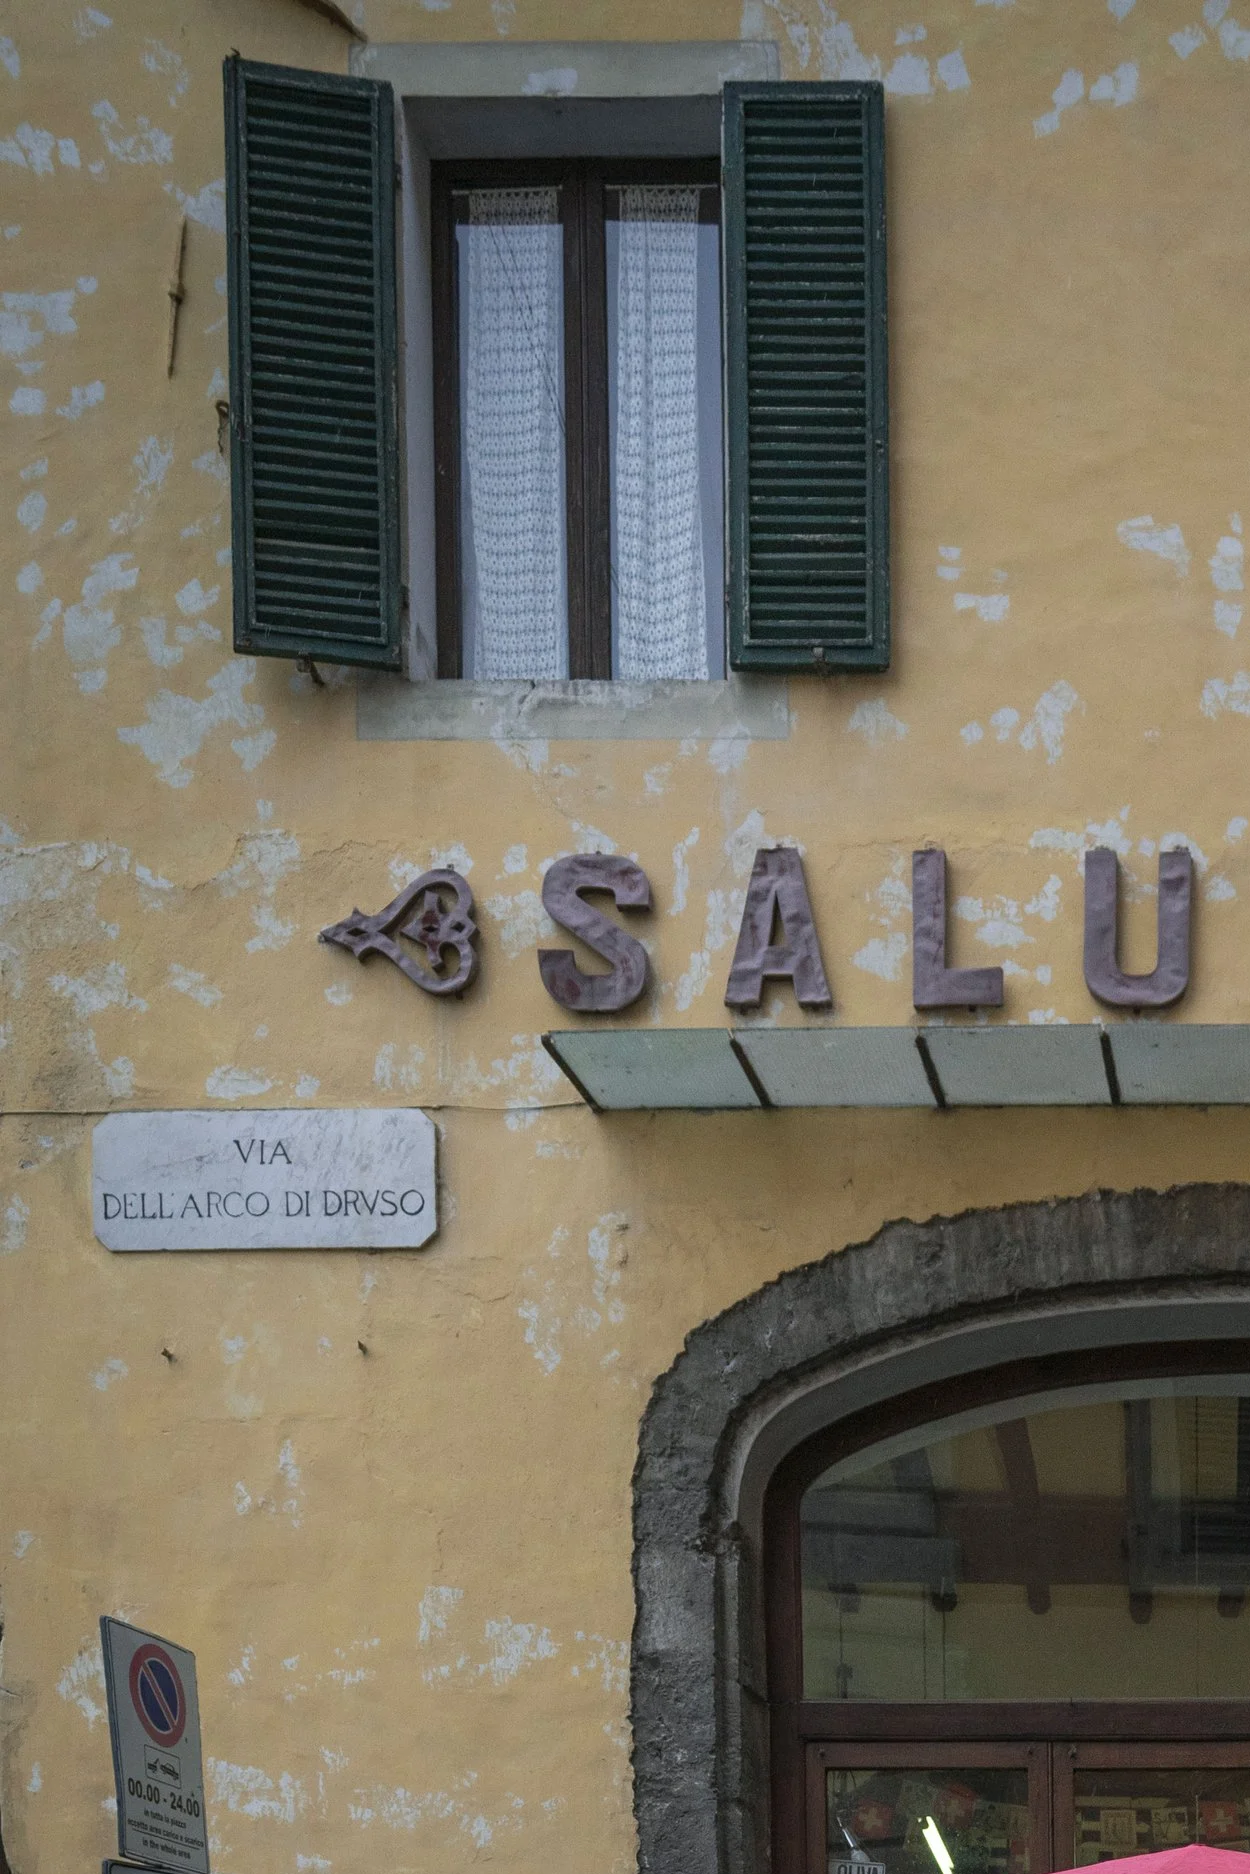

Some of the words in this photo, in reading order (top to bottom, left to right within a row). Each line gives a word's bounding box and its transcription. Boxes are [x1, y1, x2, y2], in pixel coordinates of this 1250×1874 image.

[233, 1139, 292, 1165] VIA
[103, 1191, 270, 1220] DELL'ARCO
[285, 1190, 311, 1217] DI
[128, 1777, 160, 1804] 00.00
[170, 1791, 200, 1817] 24.00
